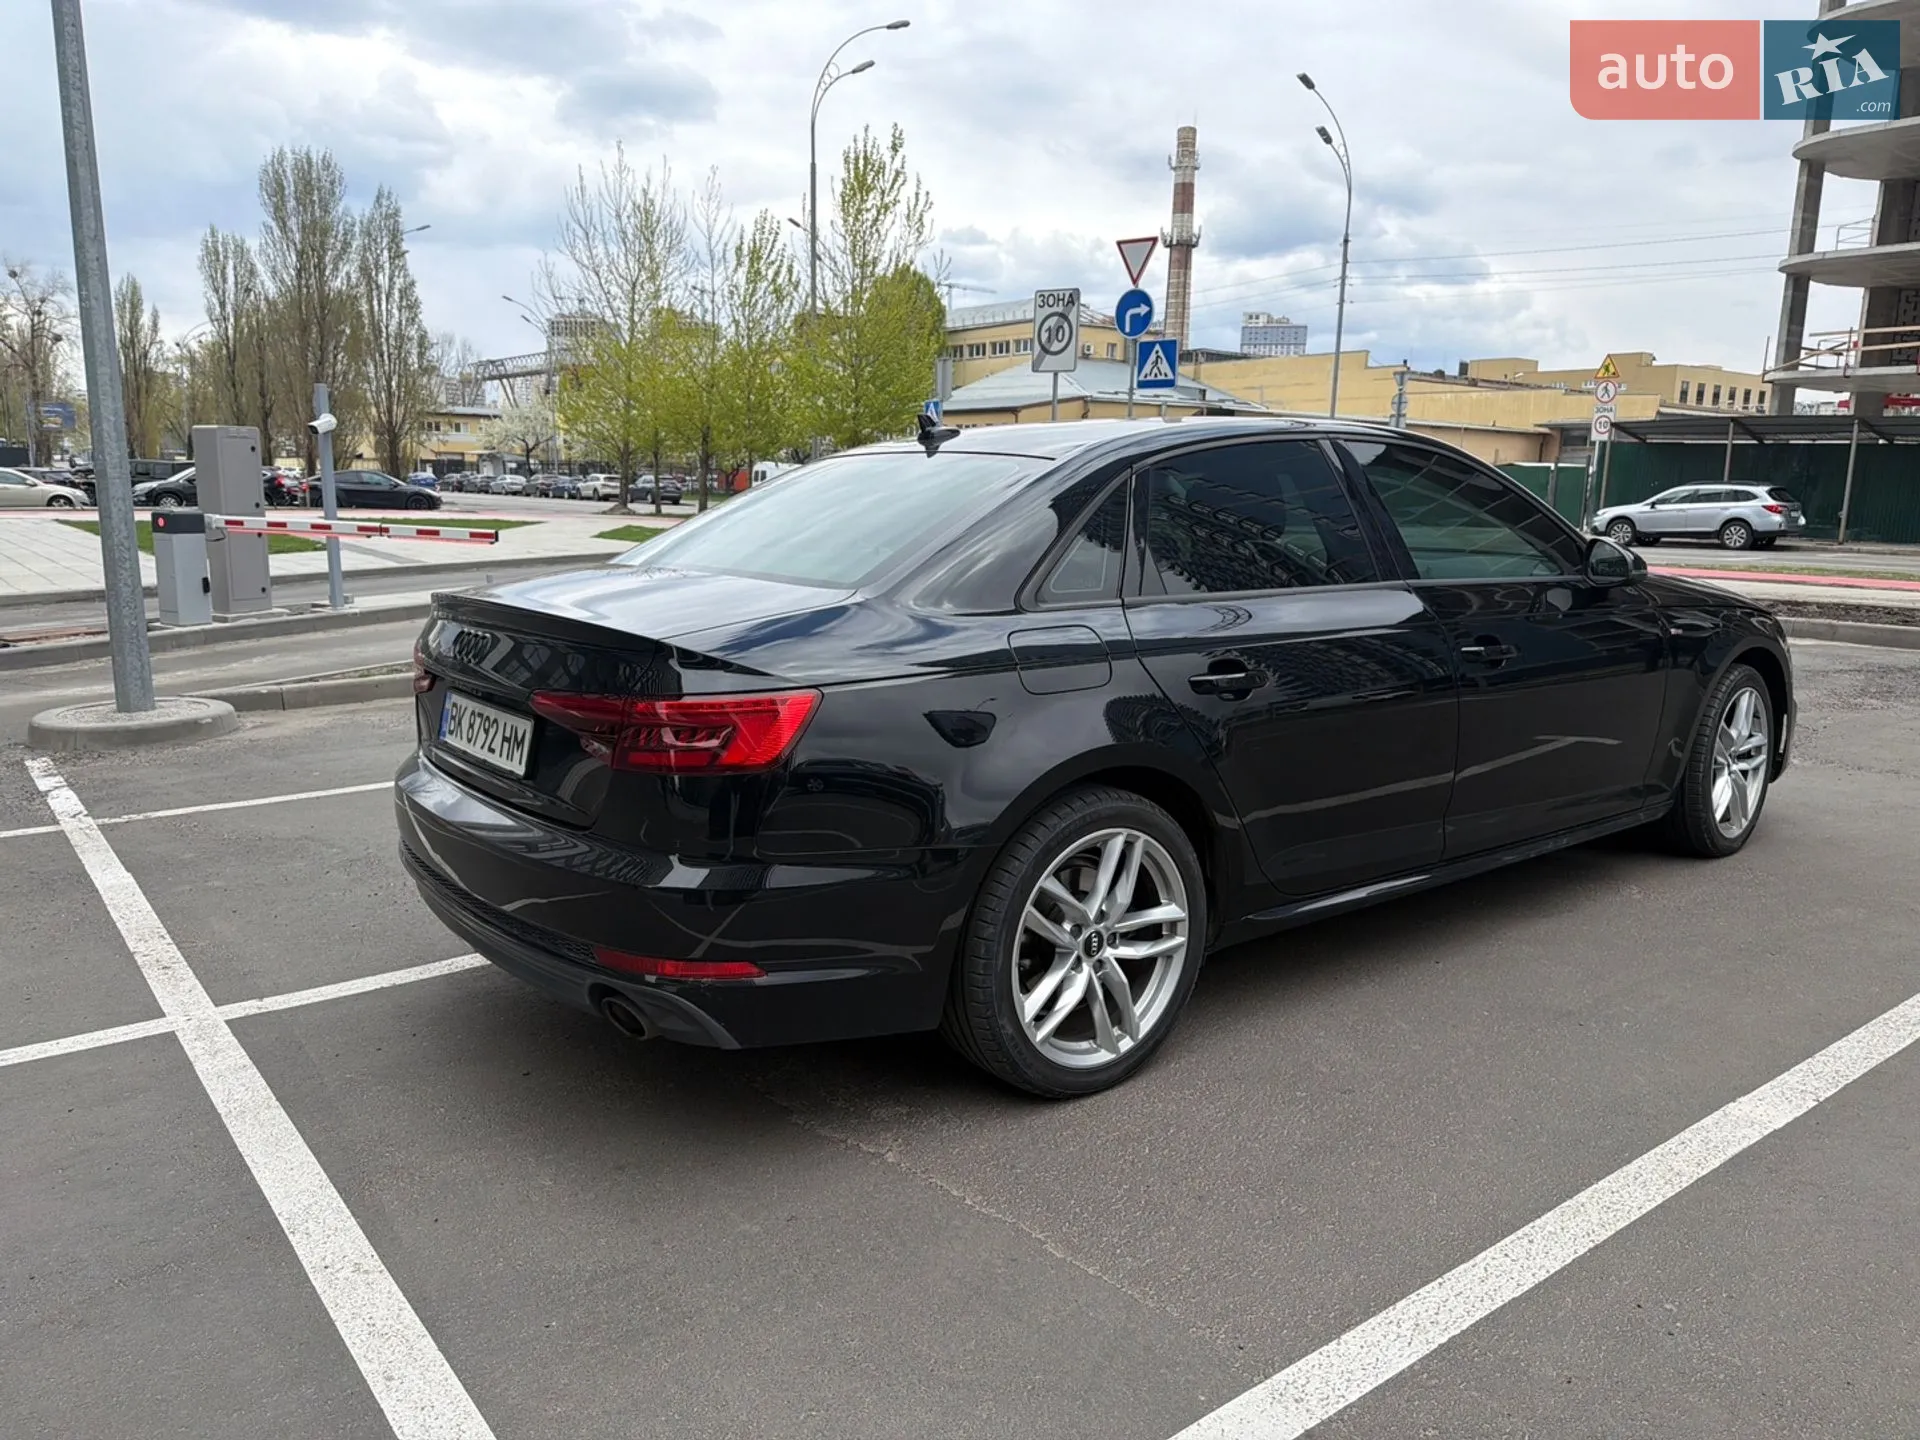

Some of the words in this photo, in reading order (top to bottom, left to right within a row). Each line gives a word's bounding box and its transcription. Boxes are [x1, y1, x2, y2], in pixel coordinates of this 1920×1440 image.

[1038, 293, 1075, 308] ЗОНА
[1044, 325, 1065, 343] 10
[1598, 420, 1609, 429] 10
[448, 702, 467, 740] BK
[466, 709, 499, 754] 8792
[499, 721, 527, 766] HM
